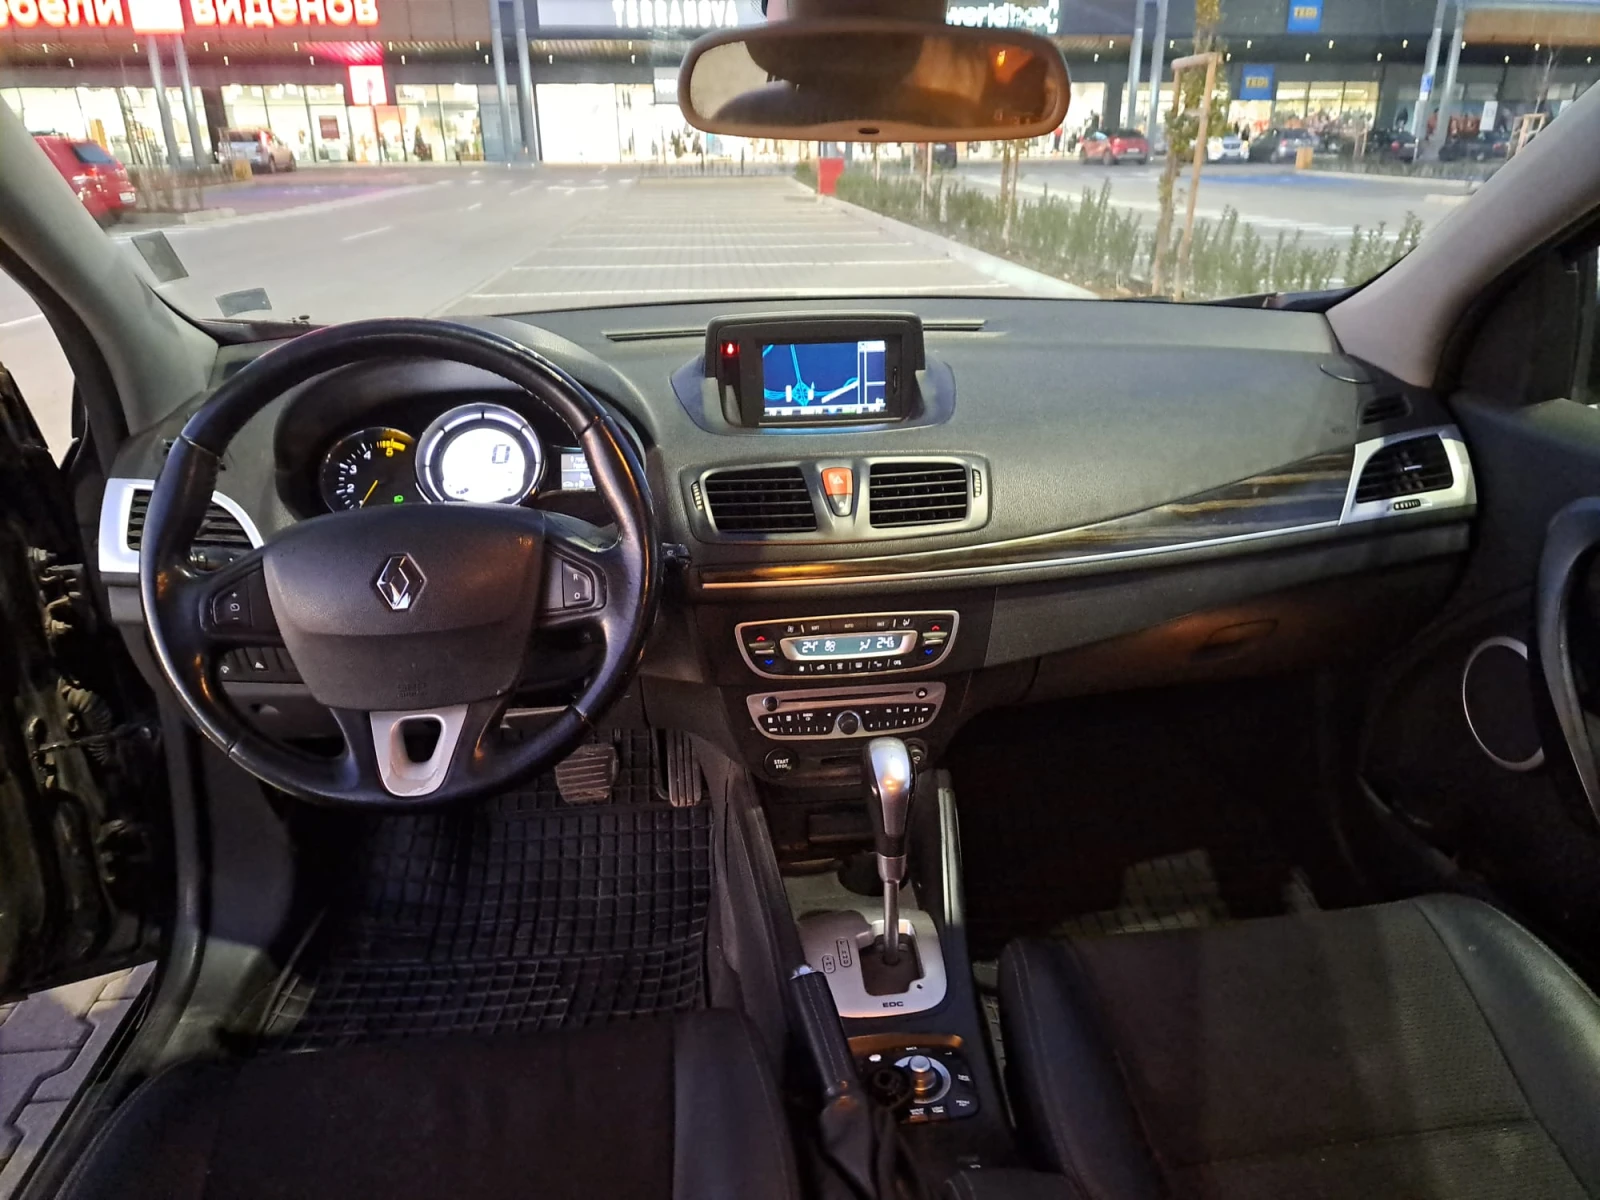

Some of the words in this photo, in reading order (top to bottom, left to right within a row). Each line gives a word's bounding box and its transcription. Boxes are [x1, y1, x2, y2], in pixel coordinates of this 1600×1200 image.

[612, 0, 738, 28] TERRANOVA
[349, 464, 357, 475] 3
[346, 483, 355, 493] 2
